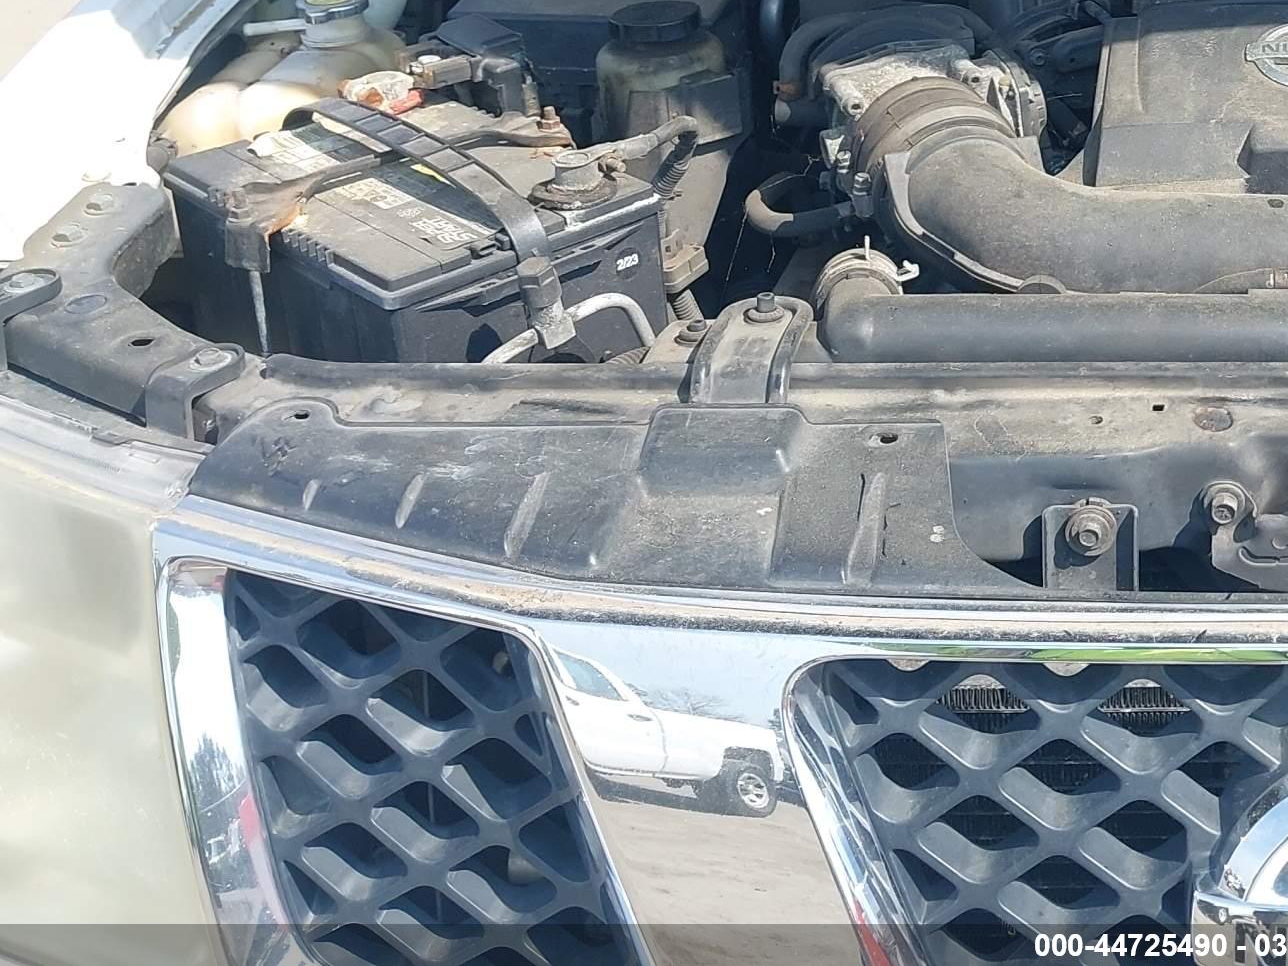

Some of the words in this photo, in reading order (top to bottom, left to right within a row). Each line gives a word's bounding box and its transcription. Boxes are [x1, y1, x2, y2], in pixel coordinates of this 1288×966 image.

[408, 220, 464, 244] SUPER
[420, 217, 478, 241] START
[616, 253, 639, 271] 2/23
